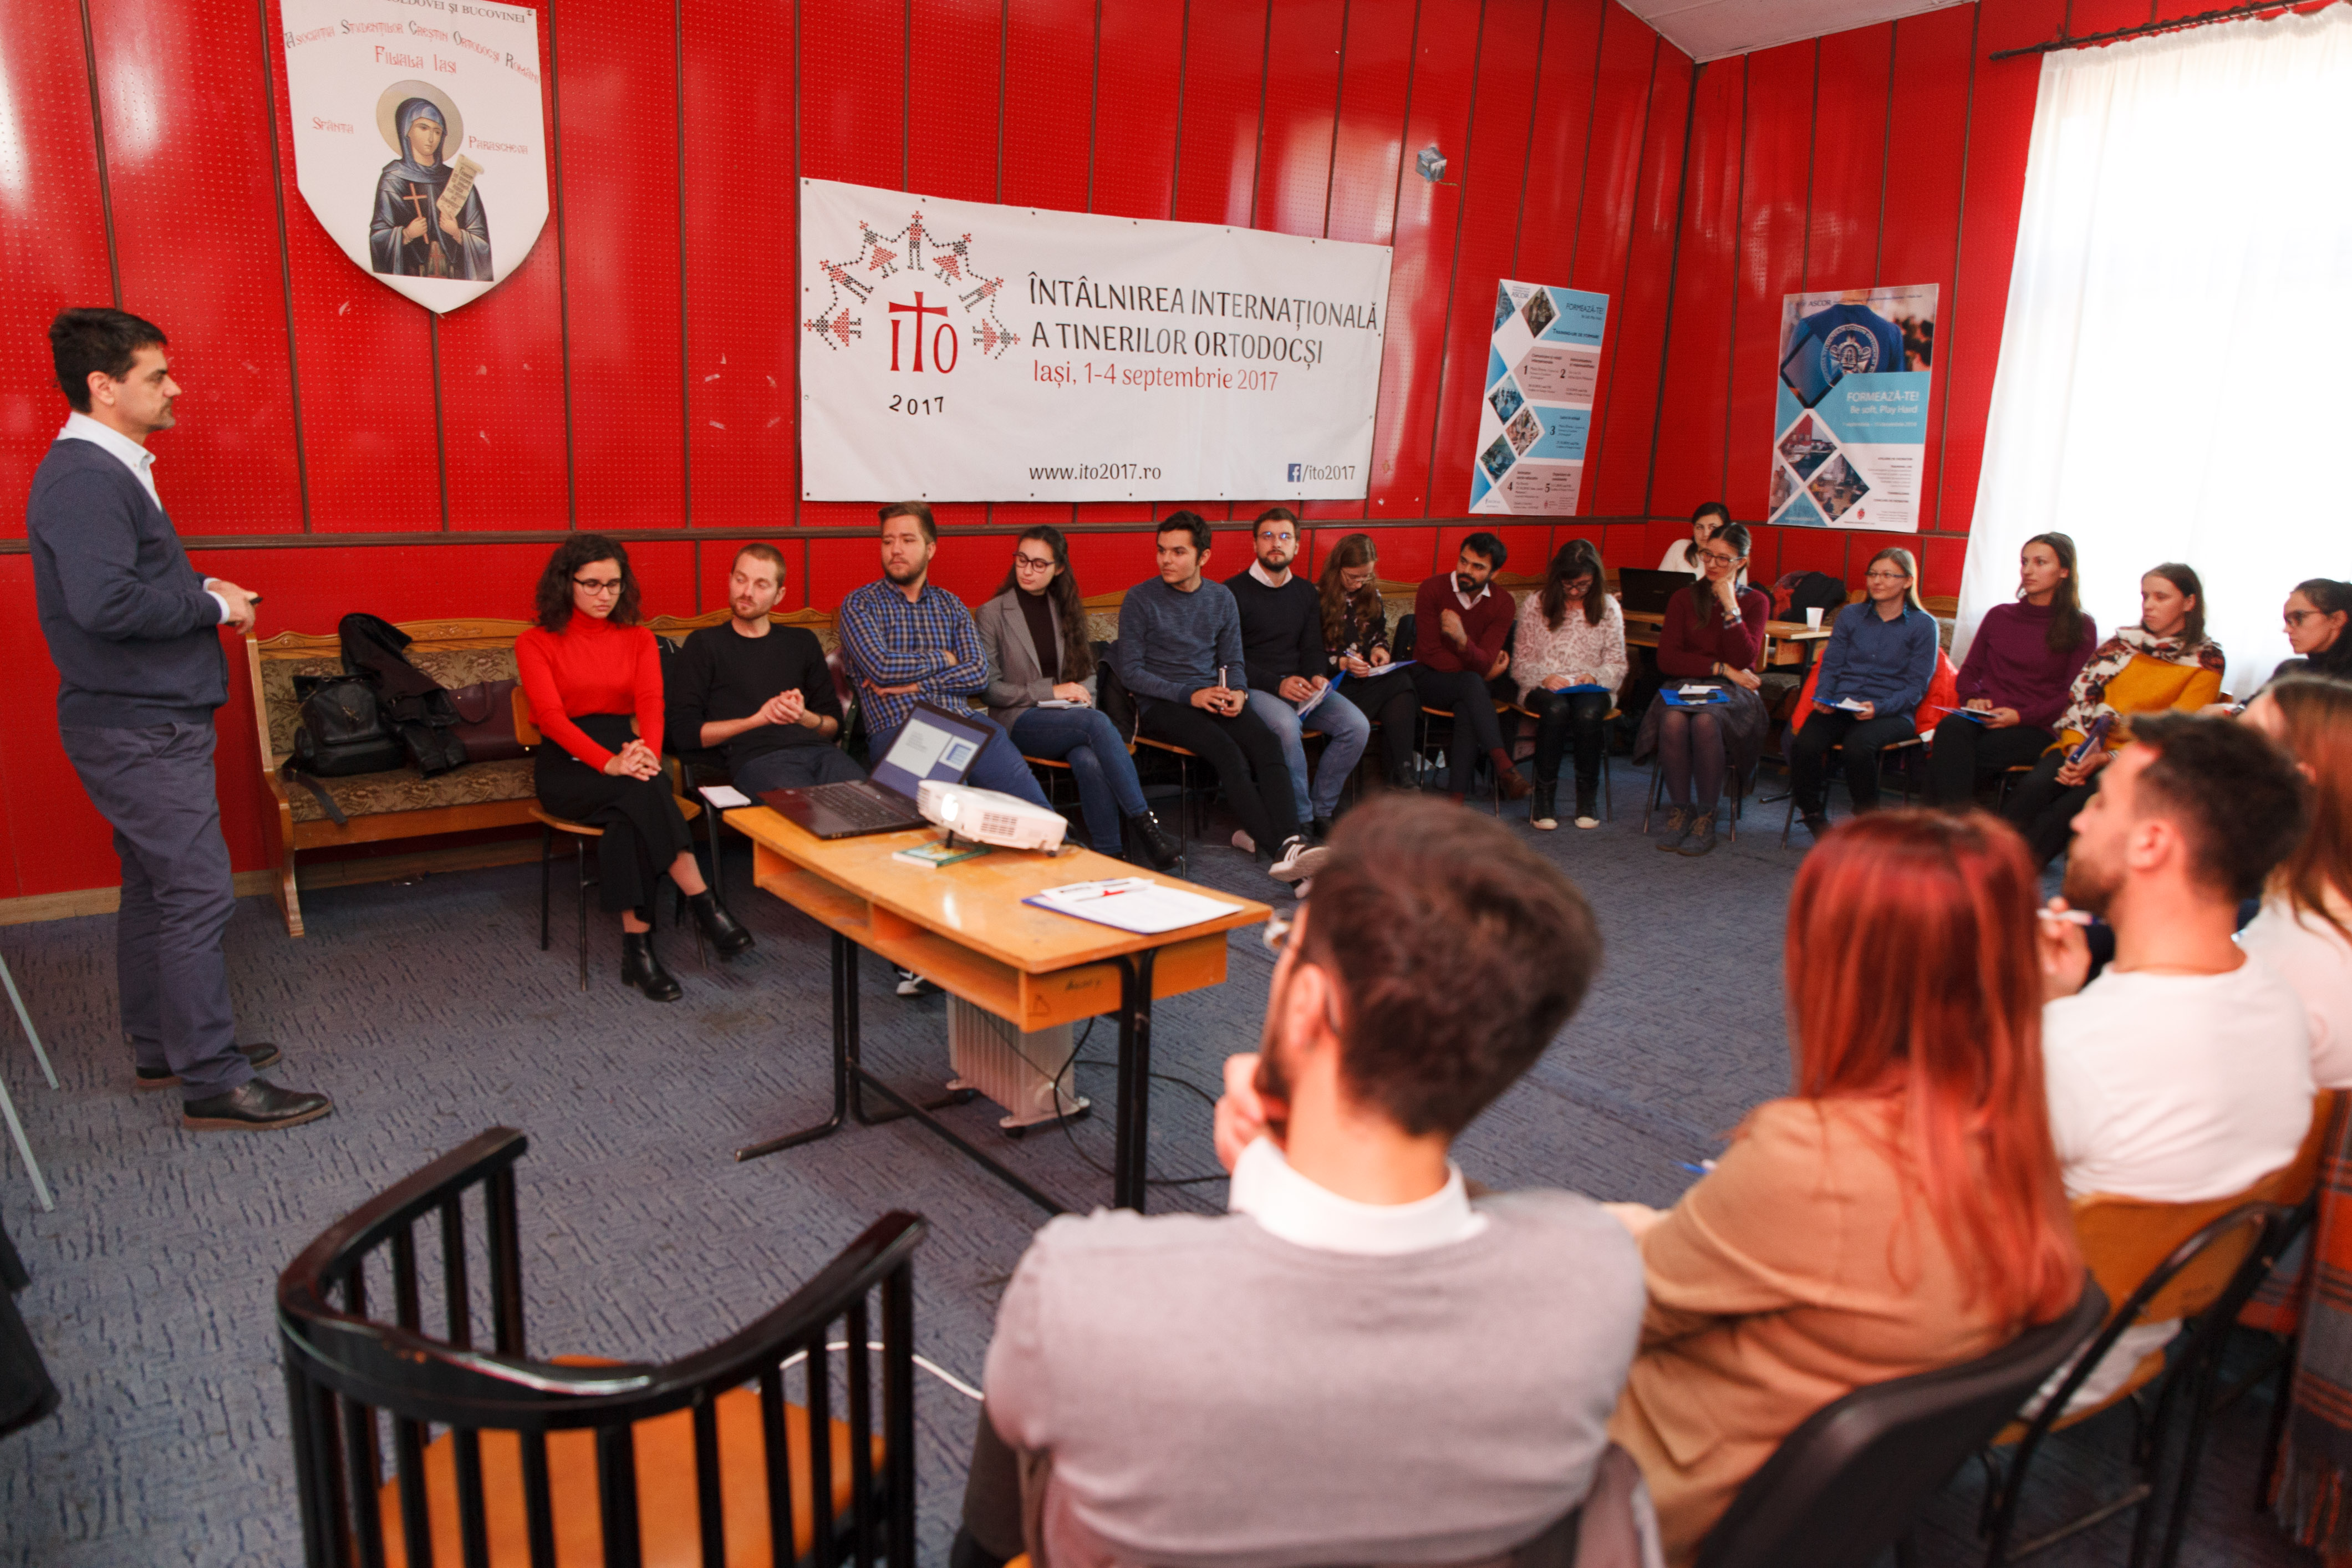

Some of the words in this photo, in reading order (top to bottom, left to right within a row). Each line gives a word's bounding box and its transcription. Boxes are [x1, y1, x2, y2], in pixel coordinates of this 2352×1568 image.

[462, 5, 525, 23] BUCOVINEI
[1028, 271, 1184, 314] ÎNTÂLNIREA
[1192, 289, 1377, 332] INTERNAȚIONALĂ
[1032, 321, 1050, 348] A
[1056, 323, 1188, 355] TINERILOR
[1194, 331, 1322, 371] ORTODOCȘI
[1034, 359, 1077, 389] Iași,
[1084, 362, 1117, 385] 1-4
[1122, 365, 1233, 391] septembrie
[1237, 369, 1279, 391] 2017
[1524, 365, 1528, 375] 1
[1560, 369, 1566, 379] 2
[889, 394, 944, 415] 2017
[1550, 425, 1556, 436] 3
[1029, 463, 1162, 480] www.ito2017.ro
[1507, 481, 1513, 491] 4
[1544, 483, 1550, 493] 5
